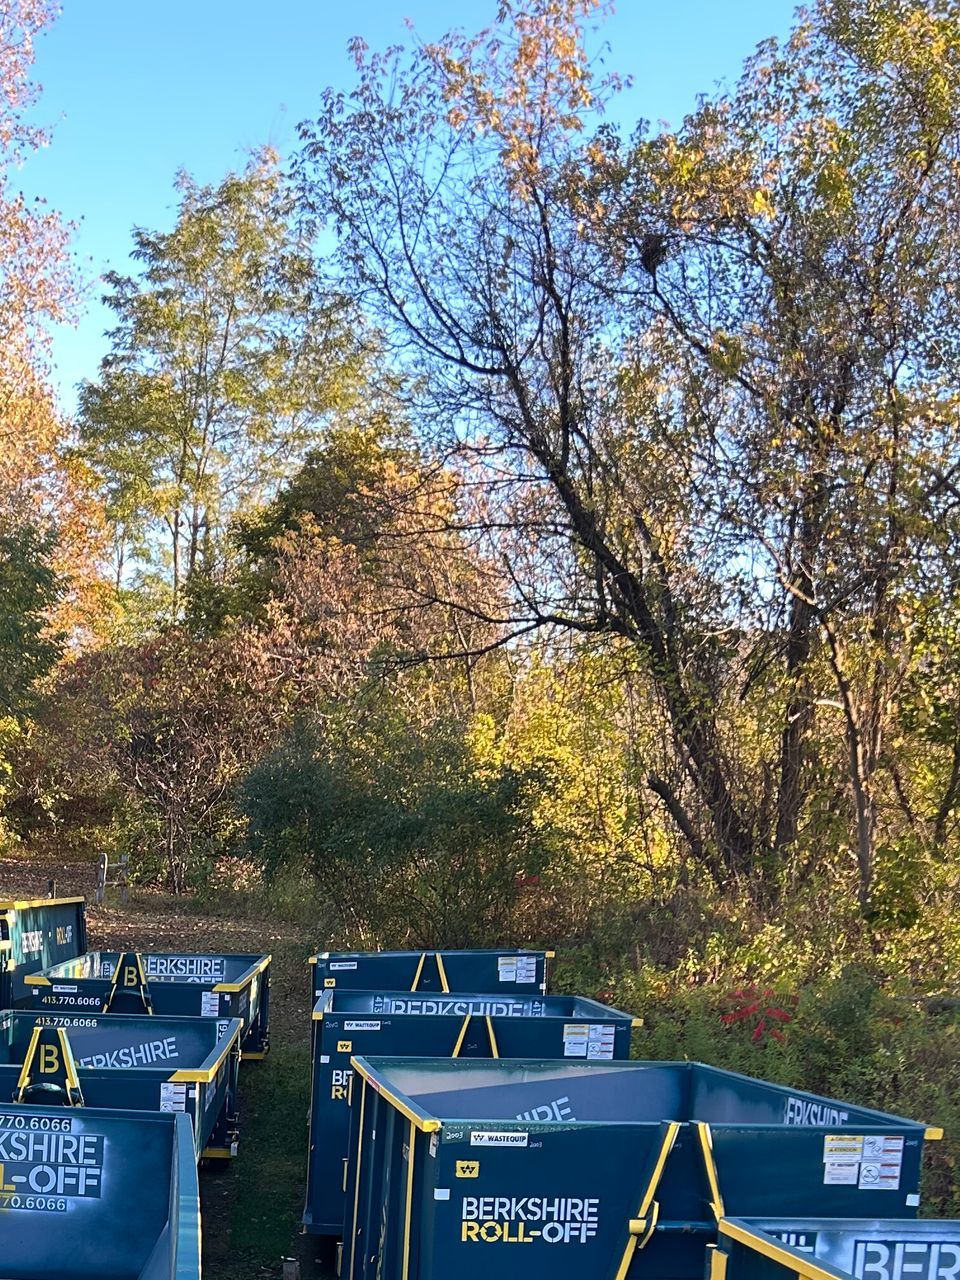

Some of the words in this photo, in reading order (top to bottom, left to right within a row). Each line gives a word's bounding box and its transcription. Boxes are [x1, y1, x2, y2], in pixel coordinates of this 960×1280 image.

[123, 966, 138, 987] B
[41, 995, 101, 1007] 413.770.6066
[34, 1017, 99, 1029] 413.770.6066
[40, 1044, 60, 1075] B
[74, 1036, 179, 1069] ERKSHIRE
[487, 1135, 527, 1144] WASTEQUIP
[461, 1197, 600, 1222] BERKSHIRE
[461, 1221, 599, 1244] ROLL-OFF
